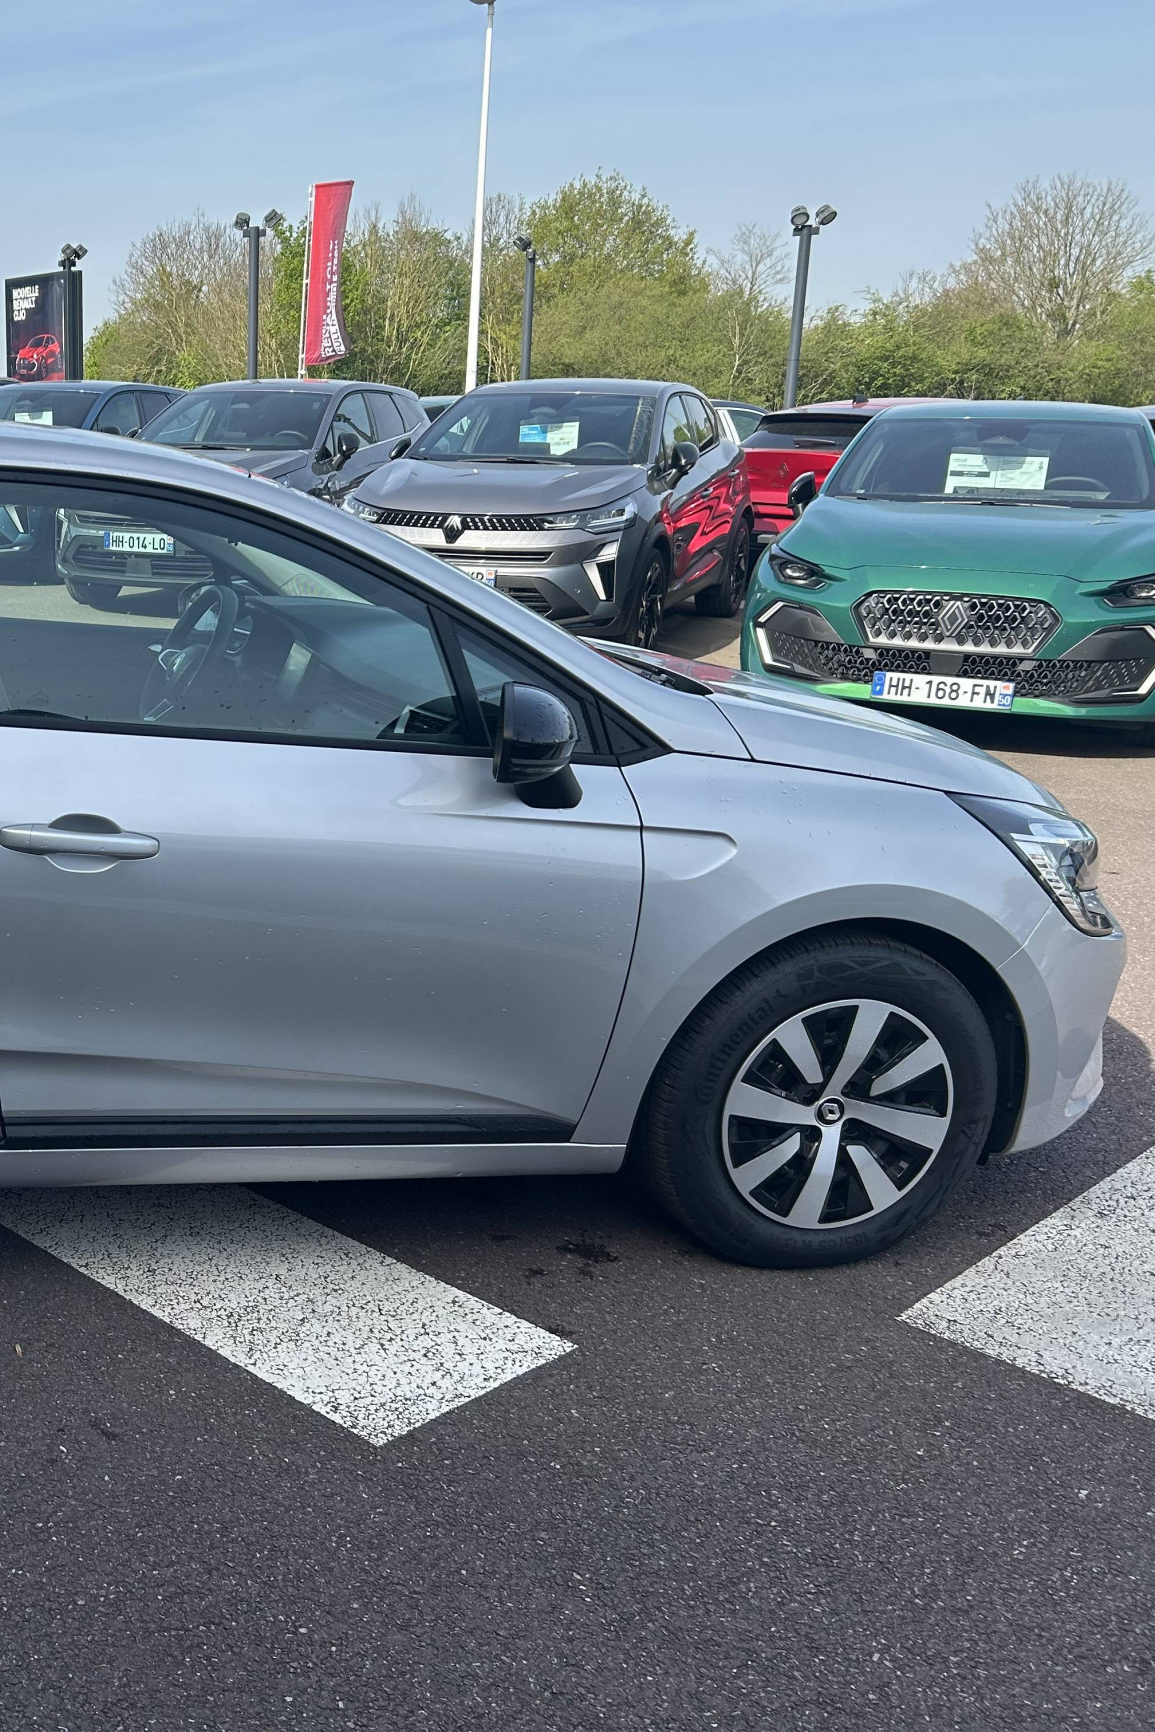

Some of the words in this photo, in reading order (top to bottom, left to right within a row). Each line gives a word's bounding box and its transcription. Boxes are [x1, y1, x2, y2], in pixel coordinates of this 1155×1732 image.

[12, 285, 39, 300] NOUVELLE
[13, 297, 36, 311] RENAULT
[13, 309, 26, 321] CLIO
[331, 328, 342, 353] FULL
[887, 676, 997, 704] HH-168-FN
[998, 696, 1011, 705] 50
[699, 1003, 774, 1102] Continental
